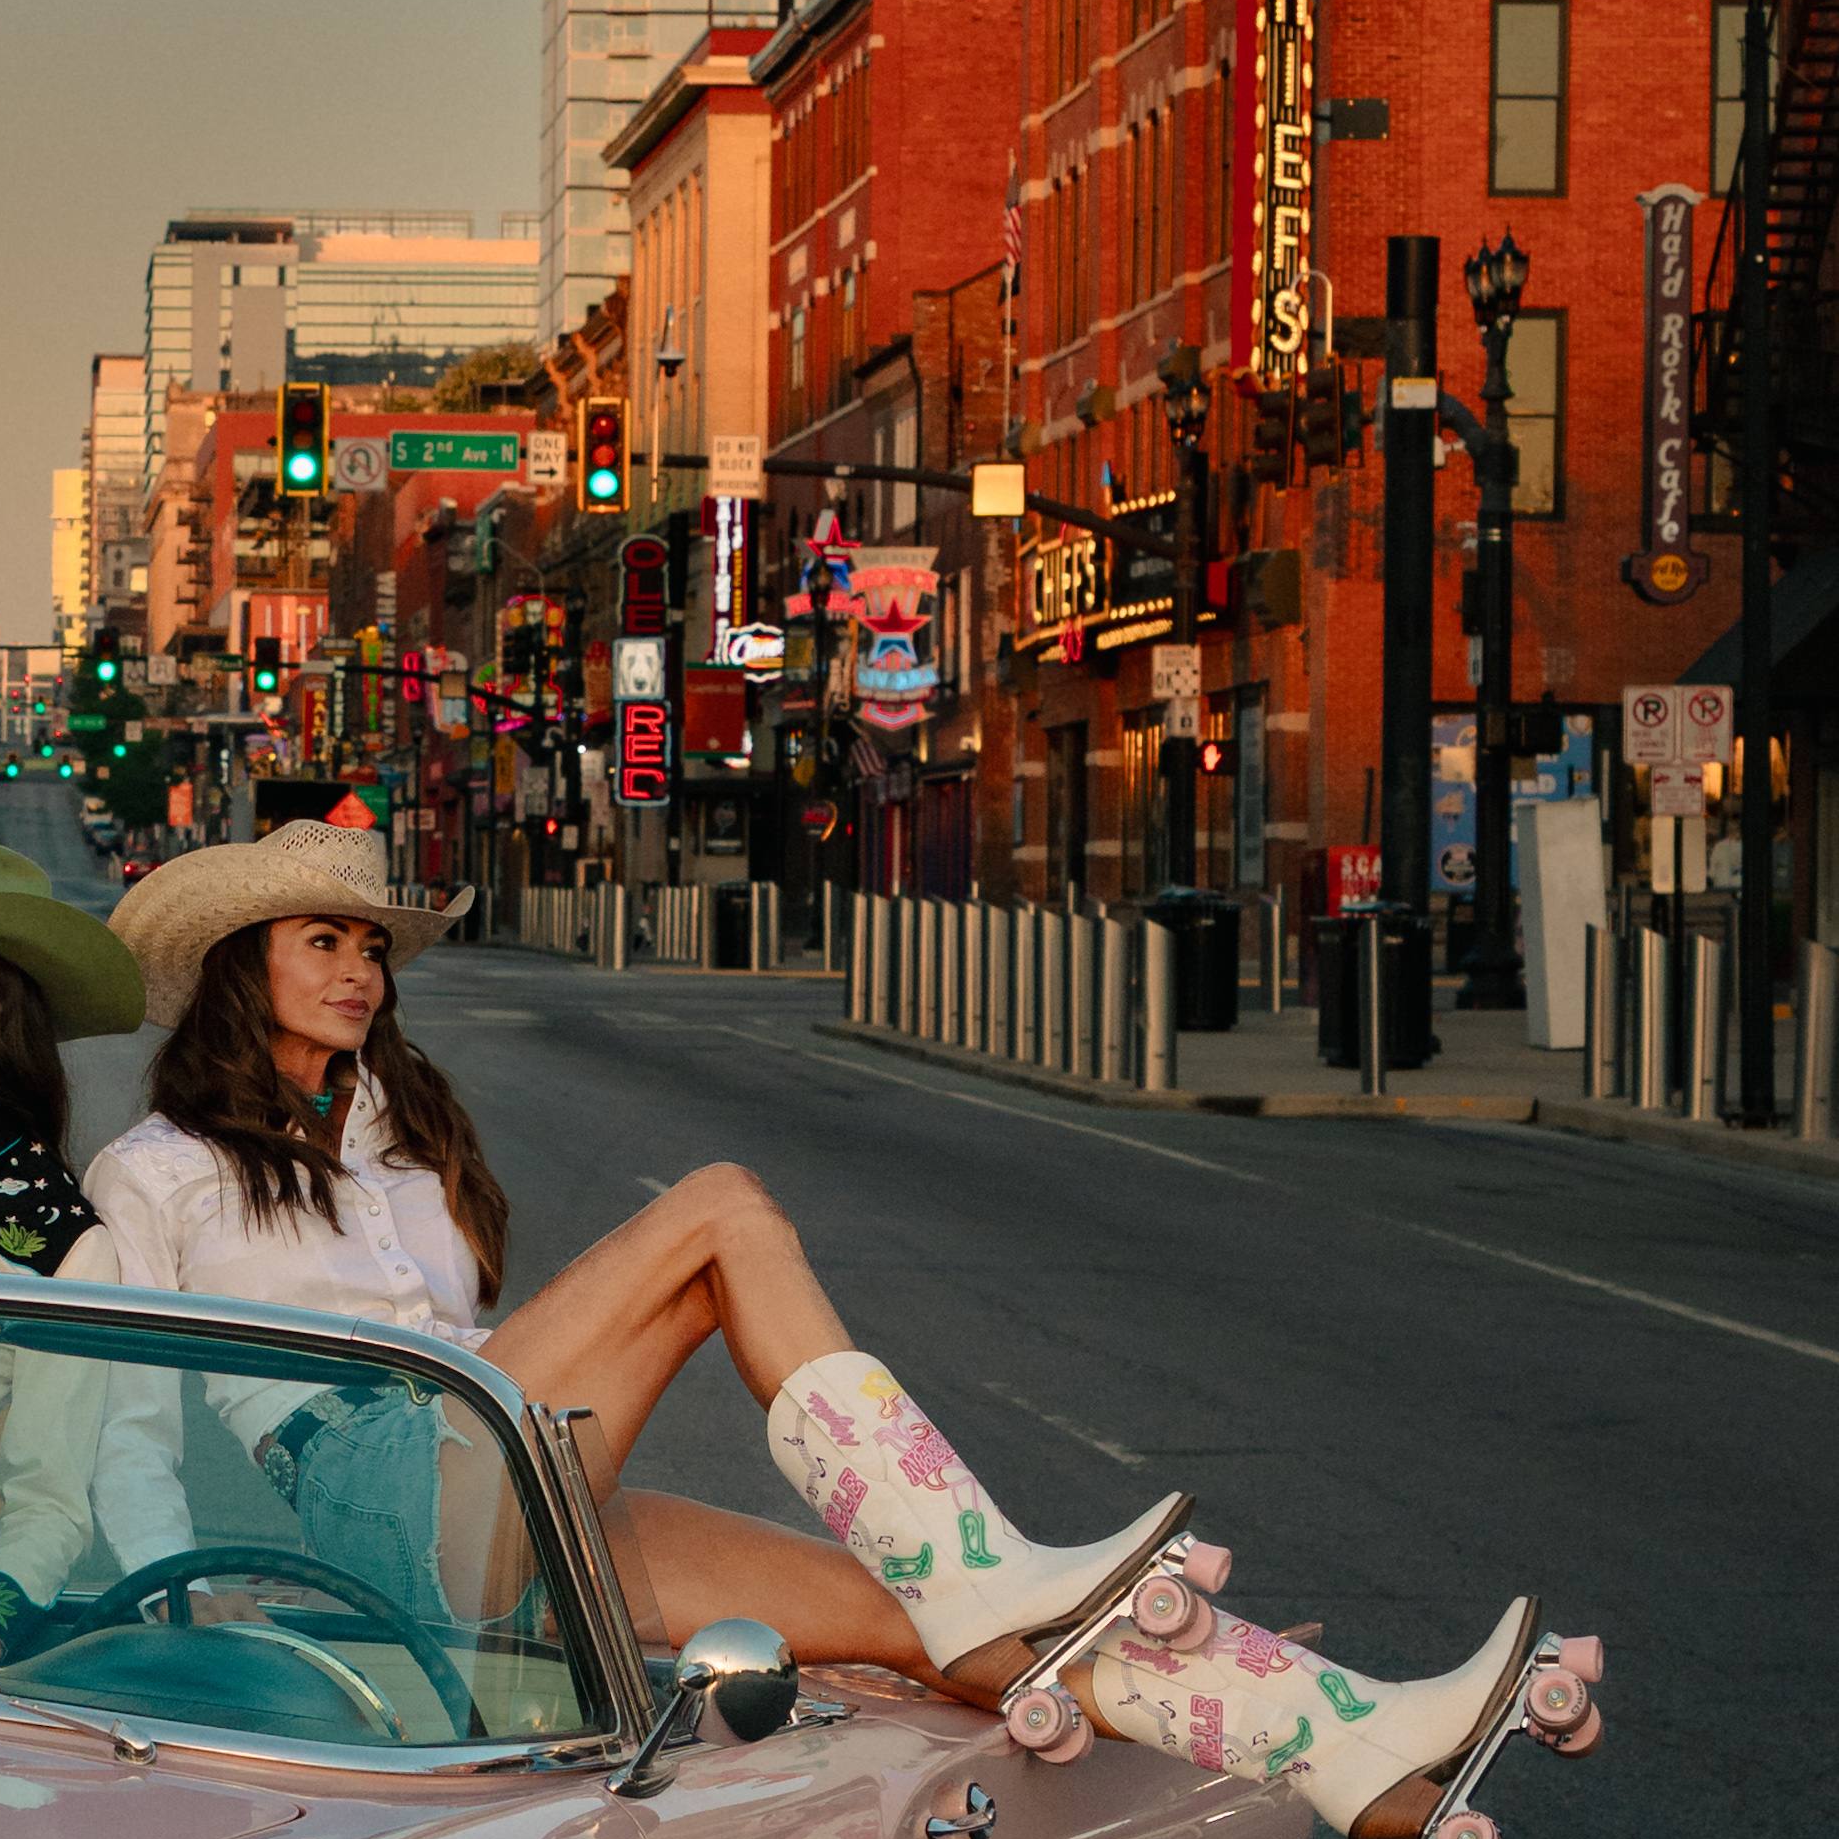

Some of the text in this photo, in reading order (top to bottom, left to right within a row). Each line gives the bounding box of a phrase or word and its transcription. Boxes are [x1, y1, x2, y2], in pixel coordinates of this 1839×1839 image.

[1659, 202, 1686, 299] Hard
[1659, 313, 1685, 425] Rock
[396, 441, 514, 463] S 2nd Ave N
[532, 436, 561, 449] ONE
[532, 452, 561, 463] WAY
[1656, 437, 1683, 544] Cafe
[624, 539, 666, 634] OLE
[623, 704, 666, 799] RED
